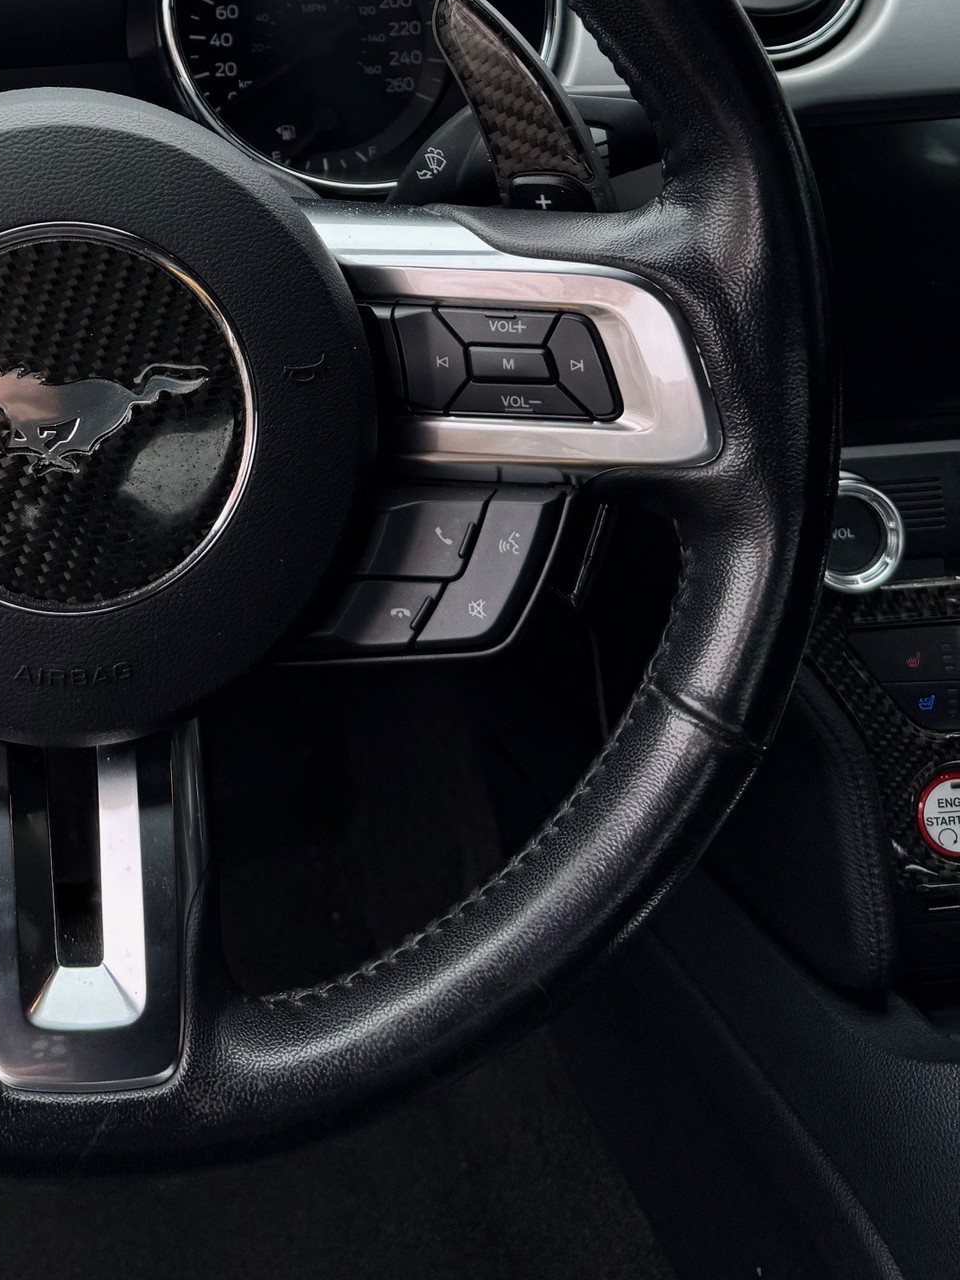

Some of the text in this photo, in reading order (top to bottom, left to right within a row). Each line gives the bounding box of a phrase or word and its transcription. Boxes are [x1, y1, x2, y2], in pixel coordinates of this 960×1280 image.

[215, 4, 239, 20] 60
[388, 20, 421, 36] 220
[209, 32, 233, 47] 40
[388, 50, 422, 66] 240
[214, 62, 237, 77] 20
[384, 76, 414, 93] 260
[502, 358, 515, 370] M
